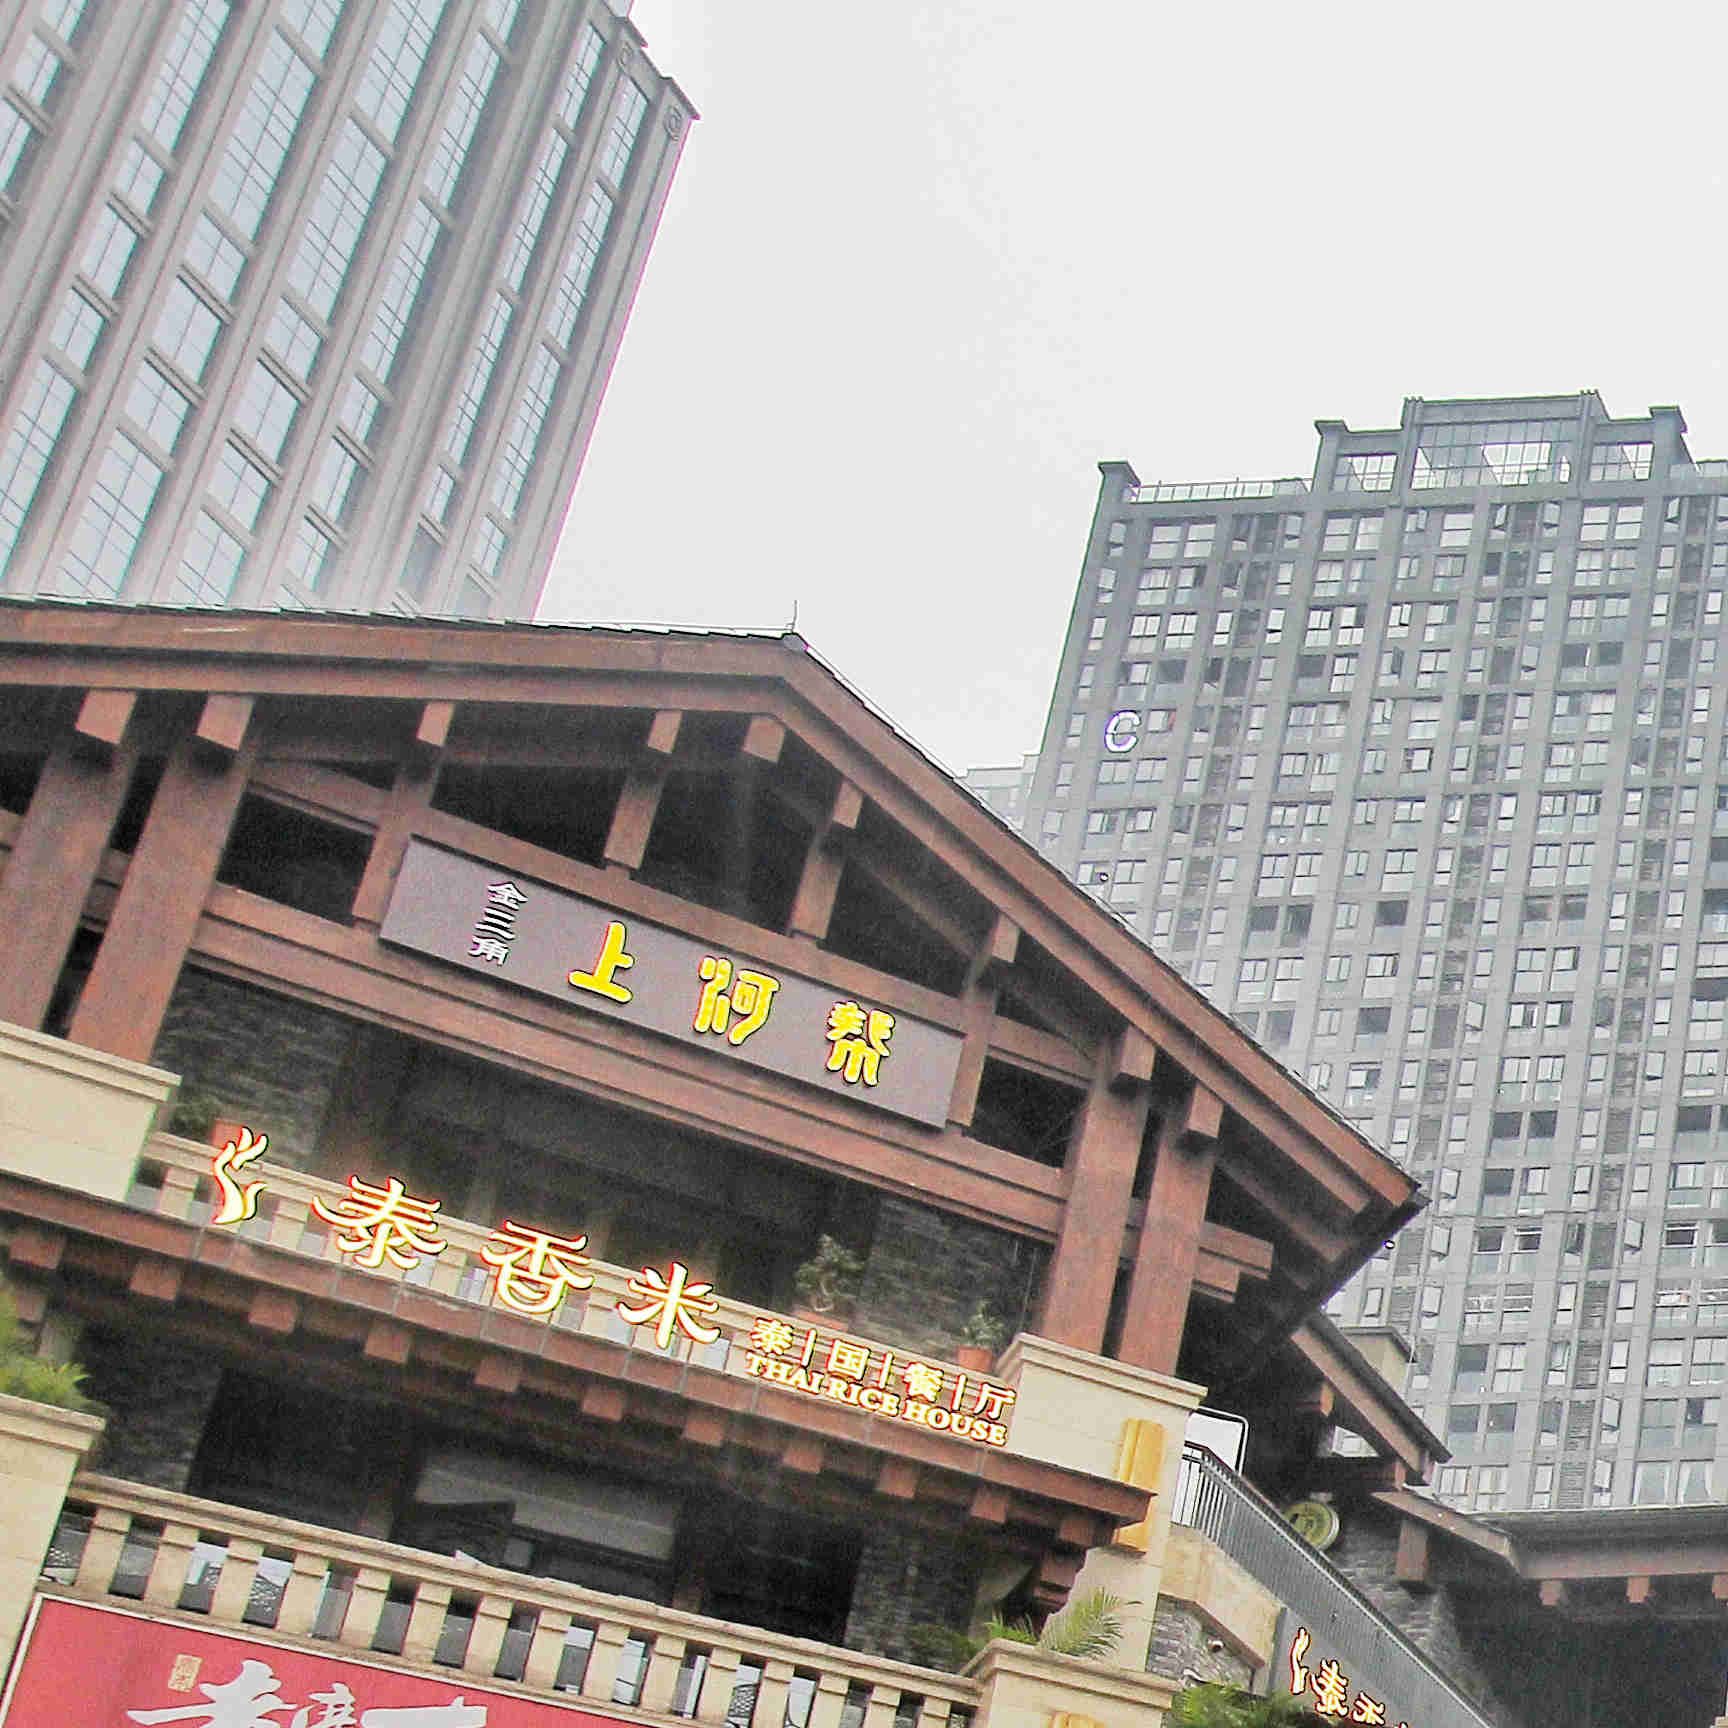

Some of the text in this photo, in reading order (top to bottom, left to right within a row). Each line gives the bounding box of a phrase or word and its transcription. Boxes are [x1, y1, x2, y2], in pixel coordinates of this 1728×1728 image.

[468, 880, 529, 967] 金三角
[567, 919, 897, 1088] 上河帮
[312, 1174, 722, 1349] 泰香米
[745, 1350, 1008, 1447] THAI RICE HOUSE
